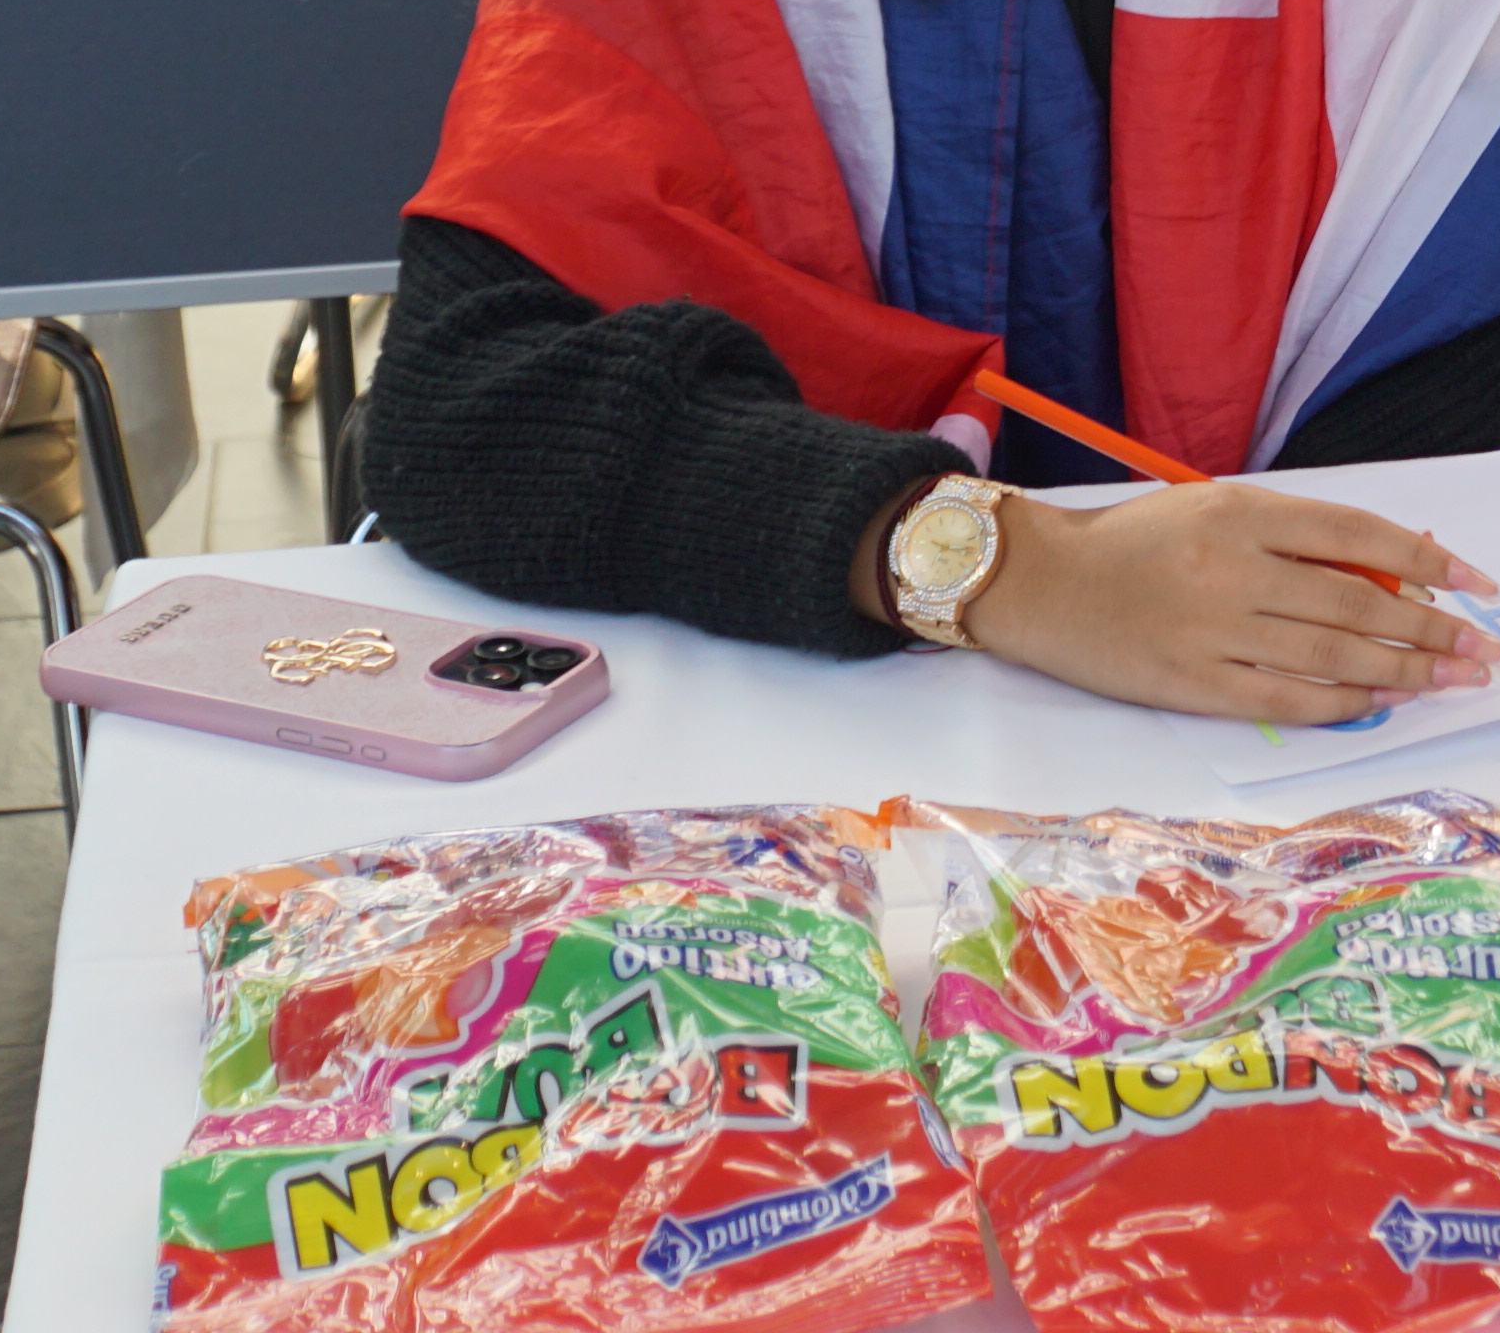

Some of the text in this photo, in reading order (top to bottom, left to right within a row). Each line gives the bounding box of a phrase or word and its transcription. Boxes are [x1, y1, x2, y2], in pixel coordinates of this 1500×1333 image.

[1010, 1030, 1280, 1136] BON
[286, 1125, 548, 1269] BON
[706, 1161, 892, 1251] Colombina
